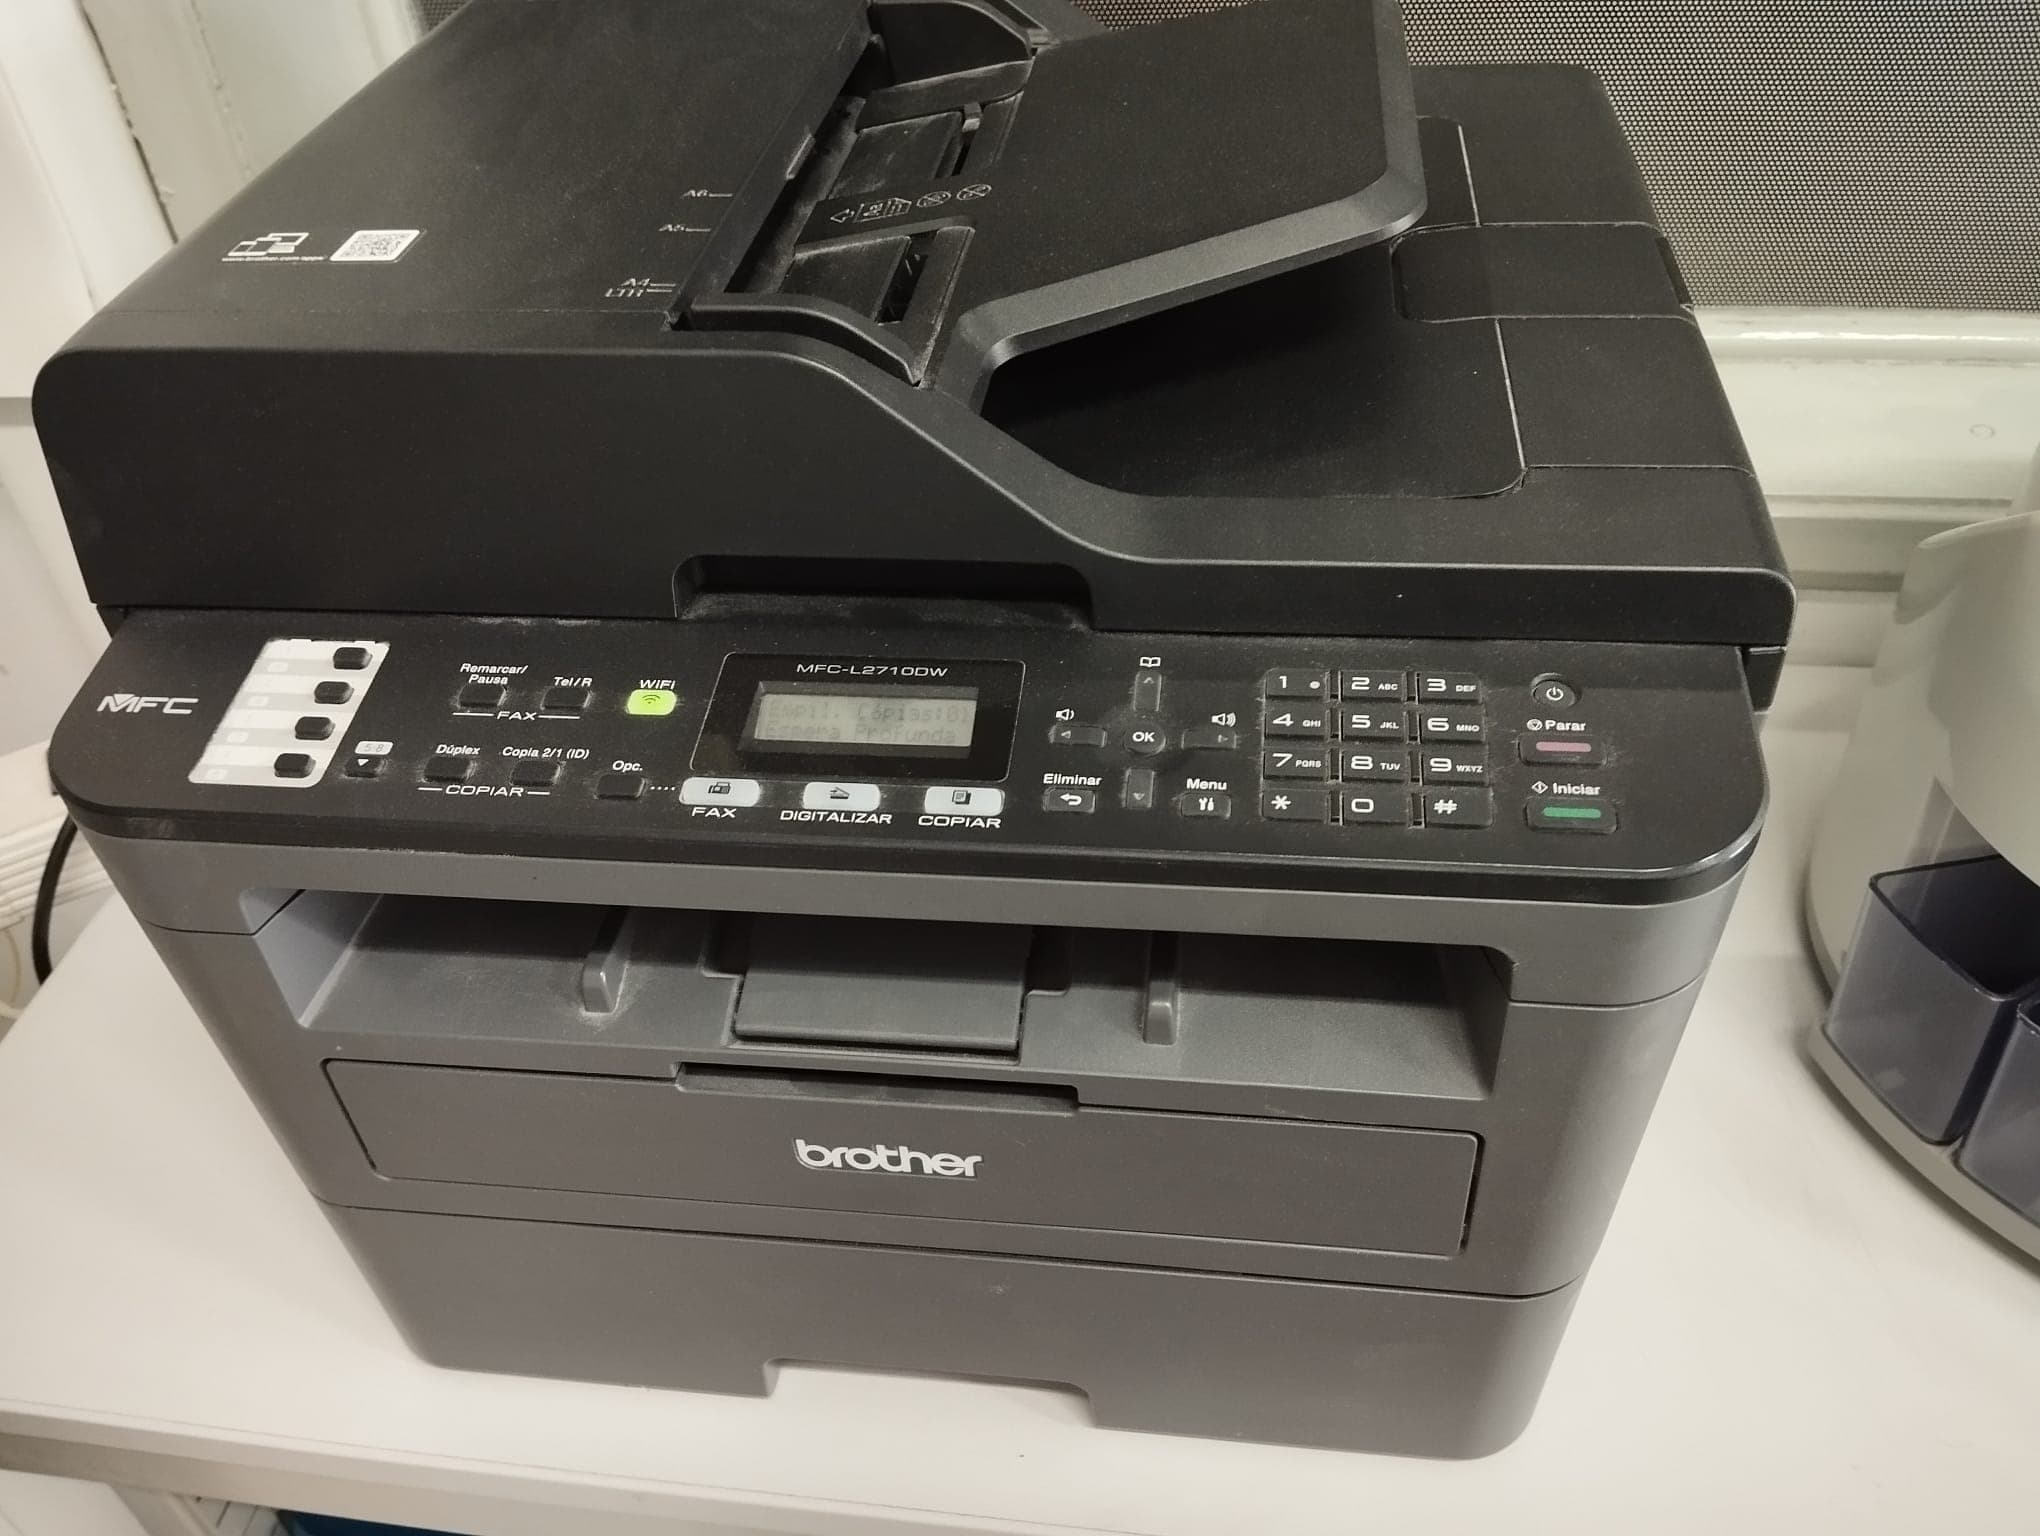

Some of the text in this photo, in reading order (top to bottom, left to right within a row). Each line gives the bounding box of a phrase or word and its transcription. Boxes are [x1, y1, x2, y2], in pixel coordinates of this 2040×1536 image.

[621, 278, 651, 287] A4
[460, 662, 528, 675] Remarcar/
[796, 663, 949, 678] MFC-L2710DW
[468, 674, 509, 686] Pausa
[1279, 675, 1288, 689] 1
[1351, 676, 1398, 691] 2 ABC
[1427, 678, 1477, 693] 3 DEF
[97, 693, 199, 715] MFC
[497, 711, 537, 721] FAX
[1272, 713, 1321, 728] 4 GHI
[1351, 714, 1400, 730] 5 JKL
[1427, 717, 1480, 733] 6 MNO
[1545, 720, 1586, 732] Parar
[1132, 731, 1156, 743] OK
[436, 744, 480, 756] Dúplex
[502, 746, 590, 760] Copia 2/1 (ID)
[612, 760, 643, 773] Opc.
[1272, 752, 1322, 769] 7 PQRS
[1351, 755, 1401, 771] 8 TUV
[1429, 757, 1484, 773] 9 WXYZ
[1043, 773, 1103, 787] Eliminar
[1186, 778, 1228, 791] Menu
[445, 784, 524, 798] COPIAR
[1552, 782, 1601, 796] Iniciar
[691, 806, 737, 819] FAX
[780, 809, 893, 825] DIGITALIZAR
[918, 815, 1002, 829] COPIAR
[795, 1138, 983, 1177] brother
